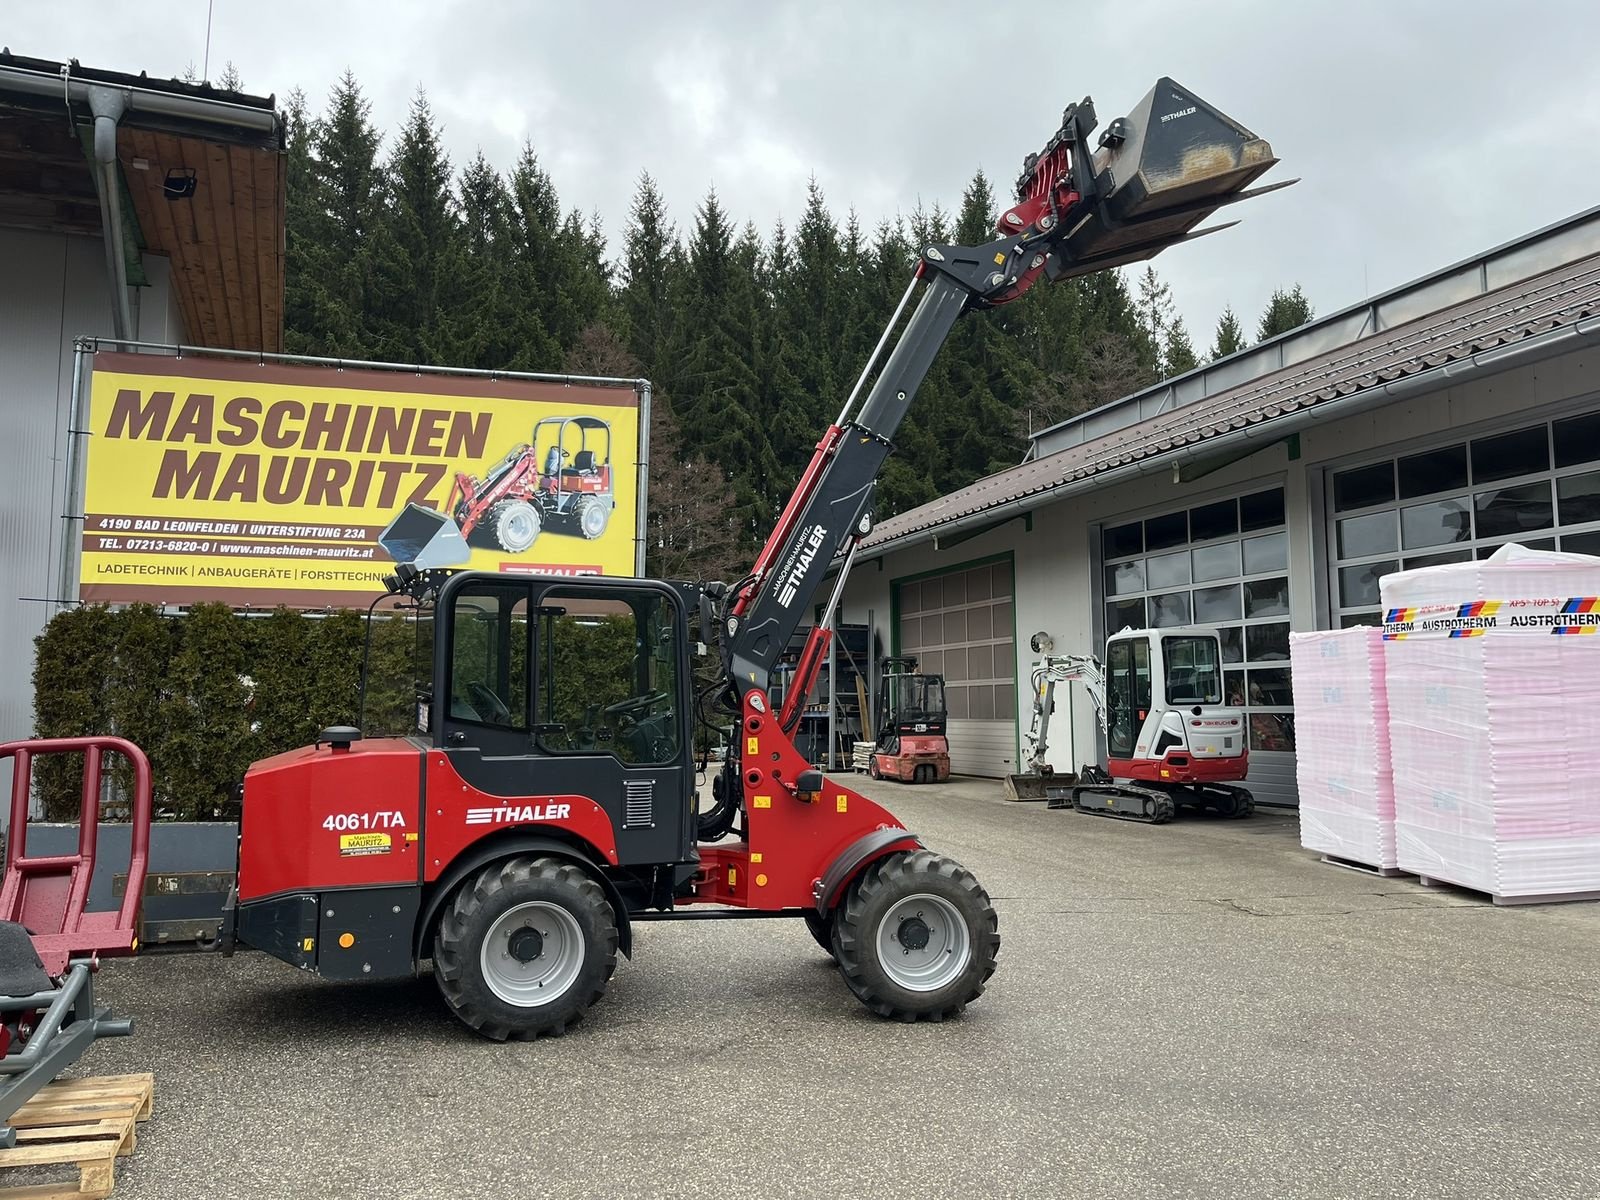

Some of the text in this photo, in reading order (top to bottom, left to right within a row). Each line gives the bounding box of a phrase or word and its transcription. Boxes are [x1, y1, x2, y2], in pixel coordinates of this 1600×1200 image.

[1170, 106, 1196, 120] THALER
[104, 388, 493, 459] MASCHINEN
[152, 448, 448, 509] MAURITZ
[99, 518, 366, 539] 4190 BAD LEONFELDEN UNTERSTIFTUNG 23A
[99, 538, 374, 558] TEL. 07213-6820-0 www.maschinen-mauritz.at
[787, 524, 827, 587] THALER
[773, 526, 810, 592] MASCHINEN-MAURITZ
[97, 564, 188, 576] LADETECHNIK
[198, 566, 291, 579] ANBAUGERÄTE
[1422, 616, 1496, 630] AUSTROTHERM
[322, 810, 406, 831] 4061/TA
[493, 803, 570, 823] THALER
[348, 838, 383, 848] MAURITZ
